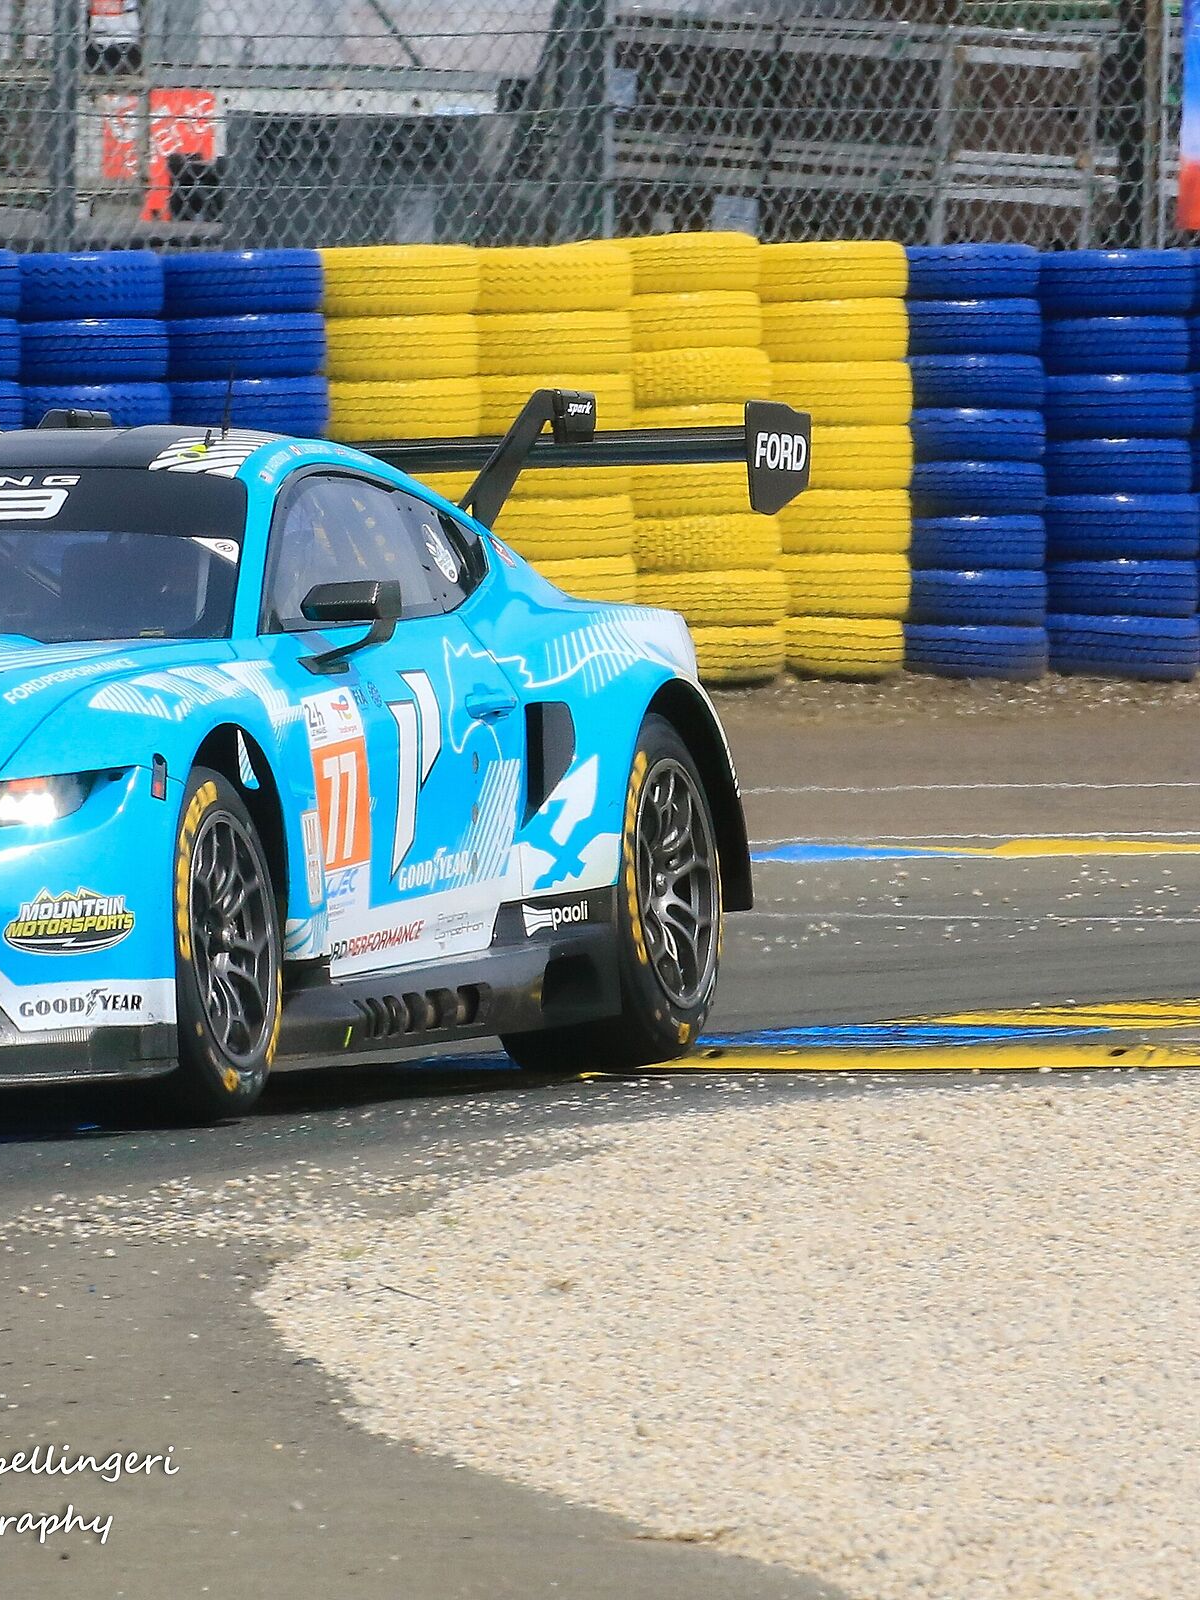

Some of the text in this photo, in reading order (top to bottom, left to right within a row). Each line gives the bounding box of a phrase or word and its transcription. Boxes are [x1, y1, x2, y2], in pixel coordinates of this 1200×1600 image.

[567, 401, 592, 416] spark
[755, 432, 807, 471] FORD
[322, 752, 357, 866] 77
[20, 896, 125, 921] MOUNTAIN
[552, 900, 588, 931] paoli
[6, 913, 134, 938] MOTORSPORTS
